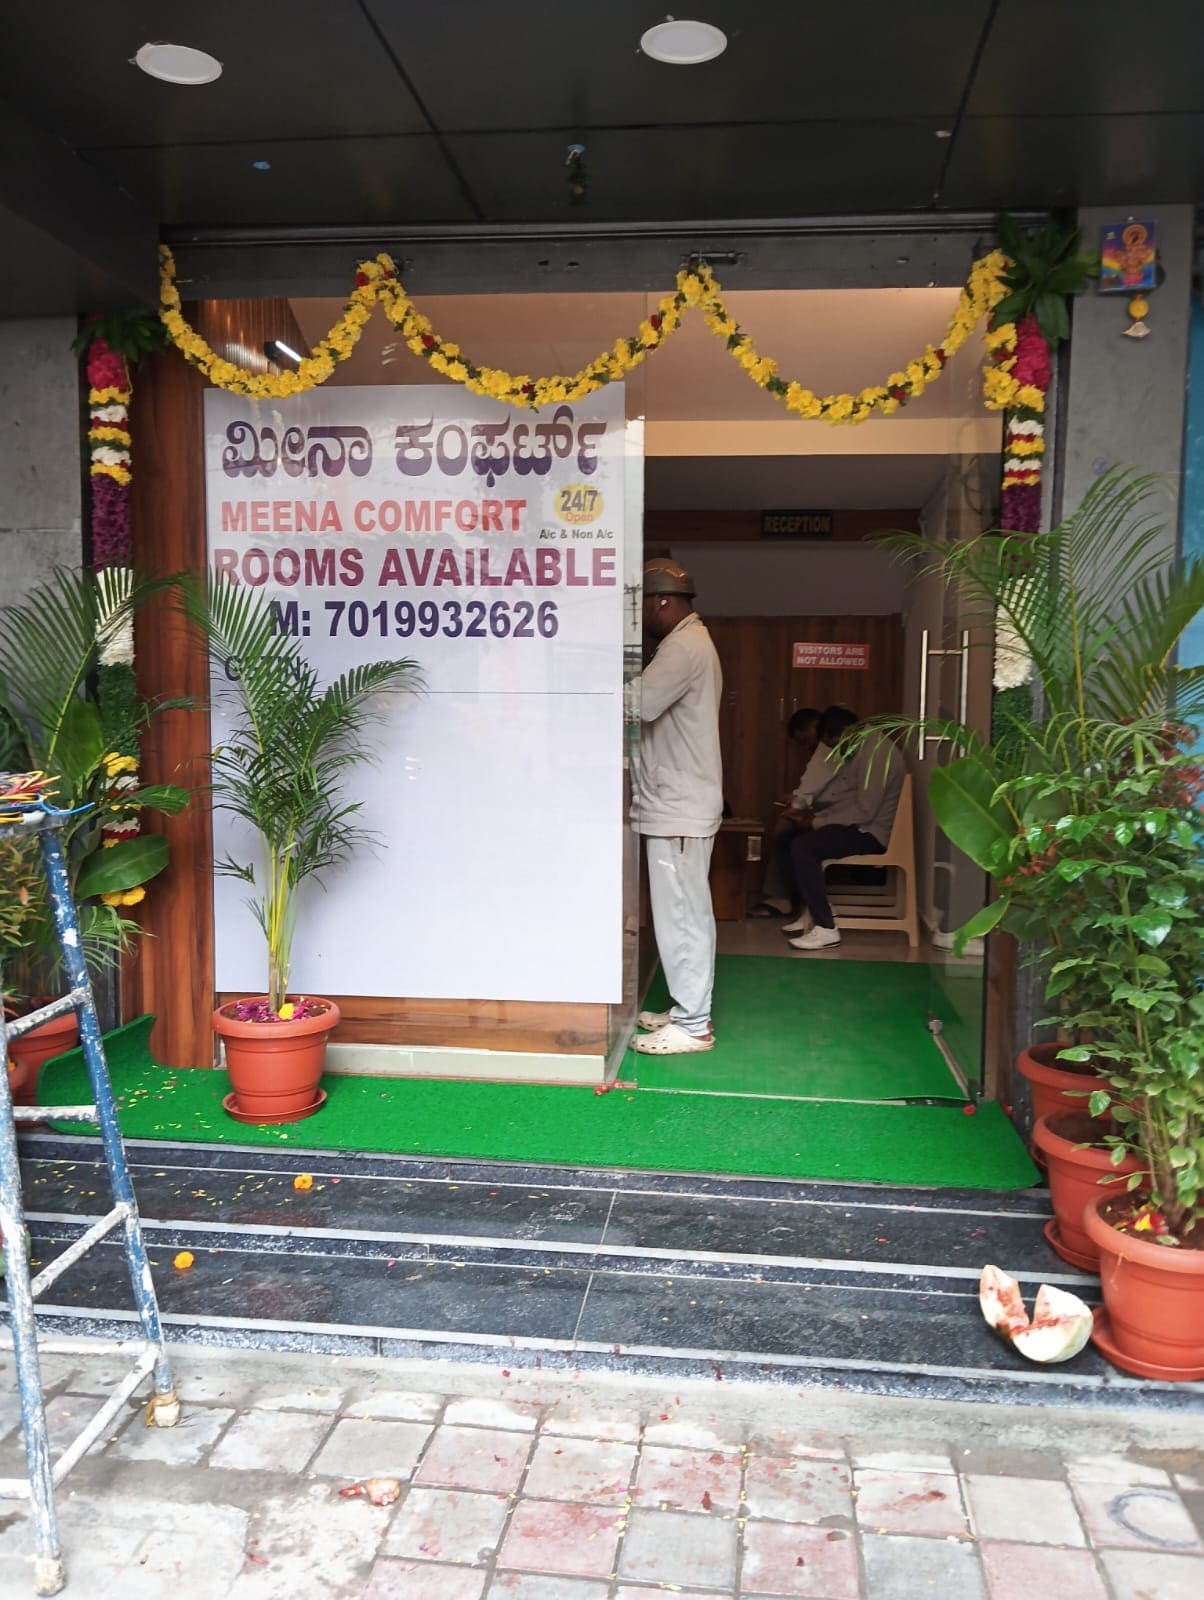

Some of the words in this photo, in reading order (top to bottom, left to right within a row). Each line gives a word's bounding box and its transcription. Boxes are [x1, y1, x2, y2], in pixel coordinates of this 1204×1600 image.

[222, 420, 373, 478] ಮೀನಾ
[560, 489, 598, 512] 24/7
[221, 500, 344, 533] MEENA
[354, 499, 527, 533] COMFORT
[565, 511, 593, 524] Open
[763, 515, 832, 533] RECEPTION
[560, 529, 568, 539] &
[571, 529, 593, 539] Non
[213, 547, 364, 587] ROOMS
[378, 547, 617, 587] AVAILABLE
[269, 600, 311, 637] M:
[324, 600, 559, 639] 7019932626
[798, 645, 843, 655] VISITORS
[845, 647, 865, 656] ARE
[796, 656, 818, 665] NOT
[819, 657, 865, 666] ALLOWED
